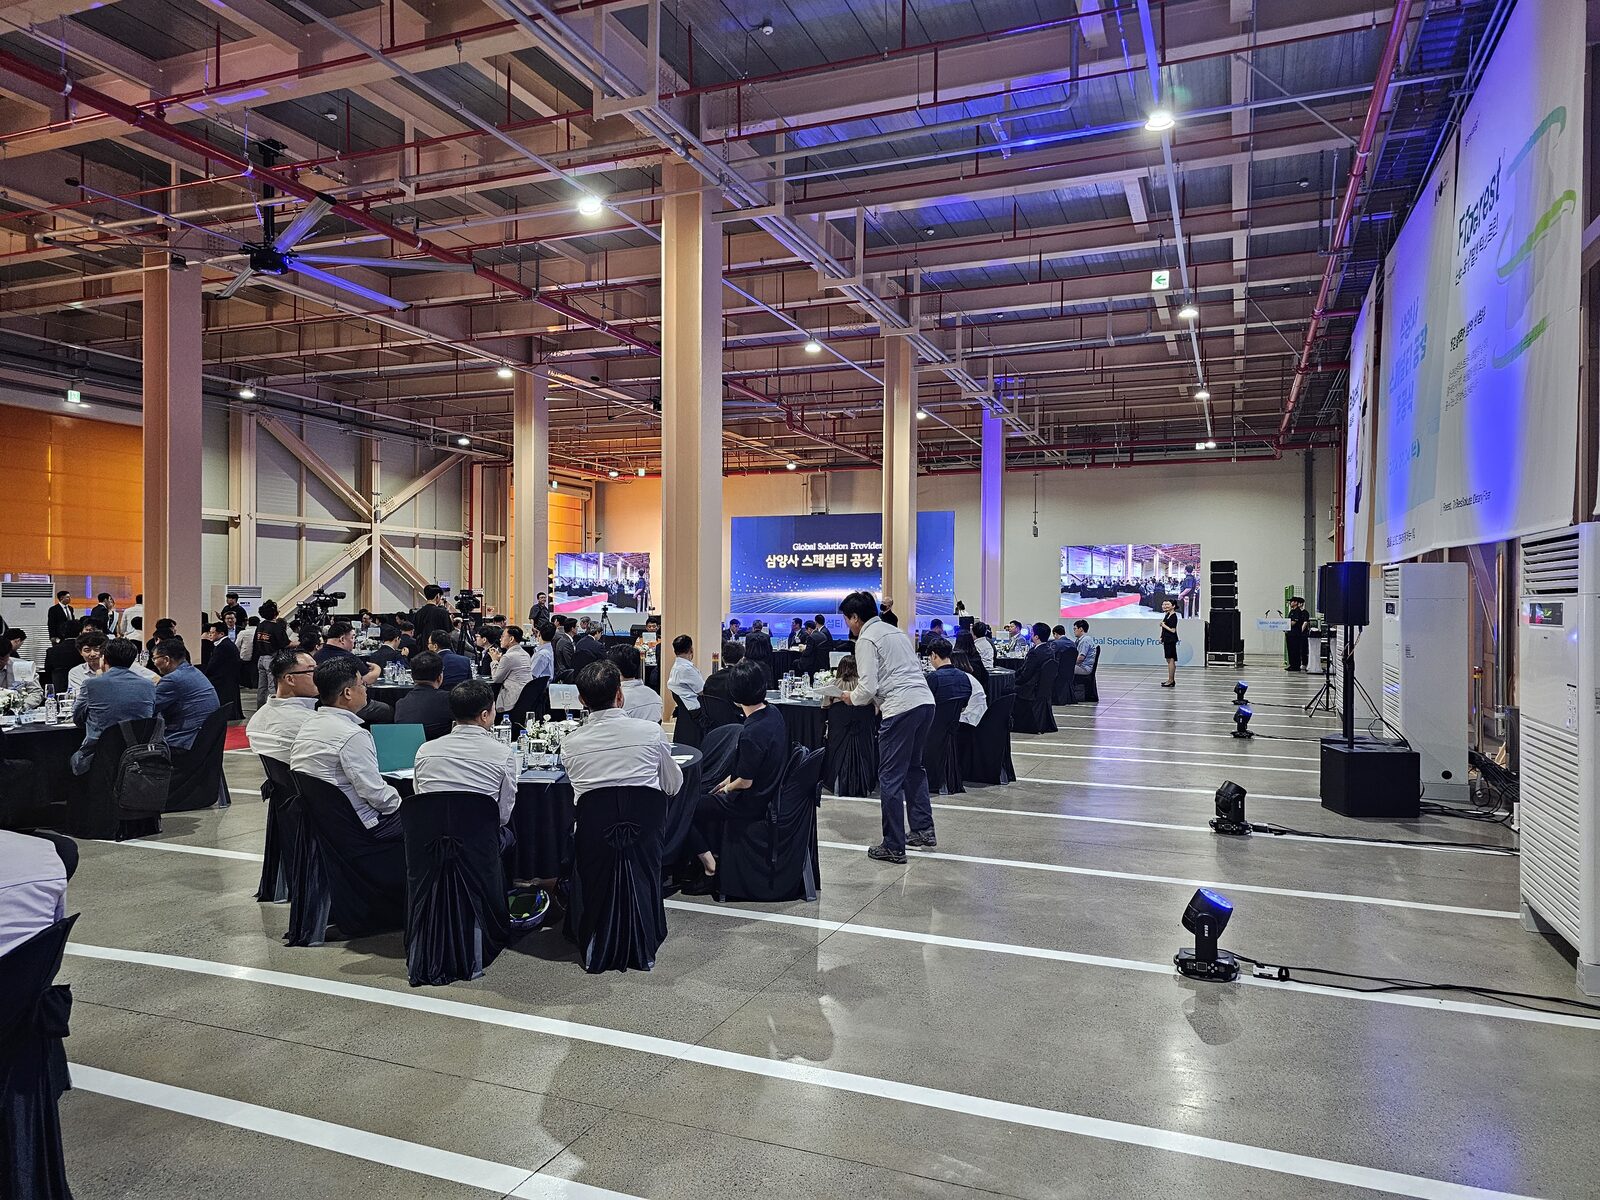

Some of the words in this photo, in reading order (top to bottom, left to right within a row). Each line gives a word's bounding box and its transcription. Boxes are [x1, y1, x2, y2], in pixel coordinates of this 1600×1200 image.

[793, 542, 816, 551] Global
[817, 542, 848, 550] Solution
[765, 553, 799, 568] 삼양사
[801, 553, 847, 568] 스페셜티
[850, 553, 874, 568] 공장
[826, 619, 843, 629] 셜티
[1092, 637, 1106, 646] bal
[1107, 637, 1145, 647] Specialty
